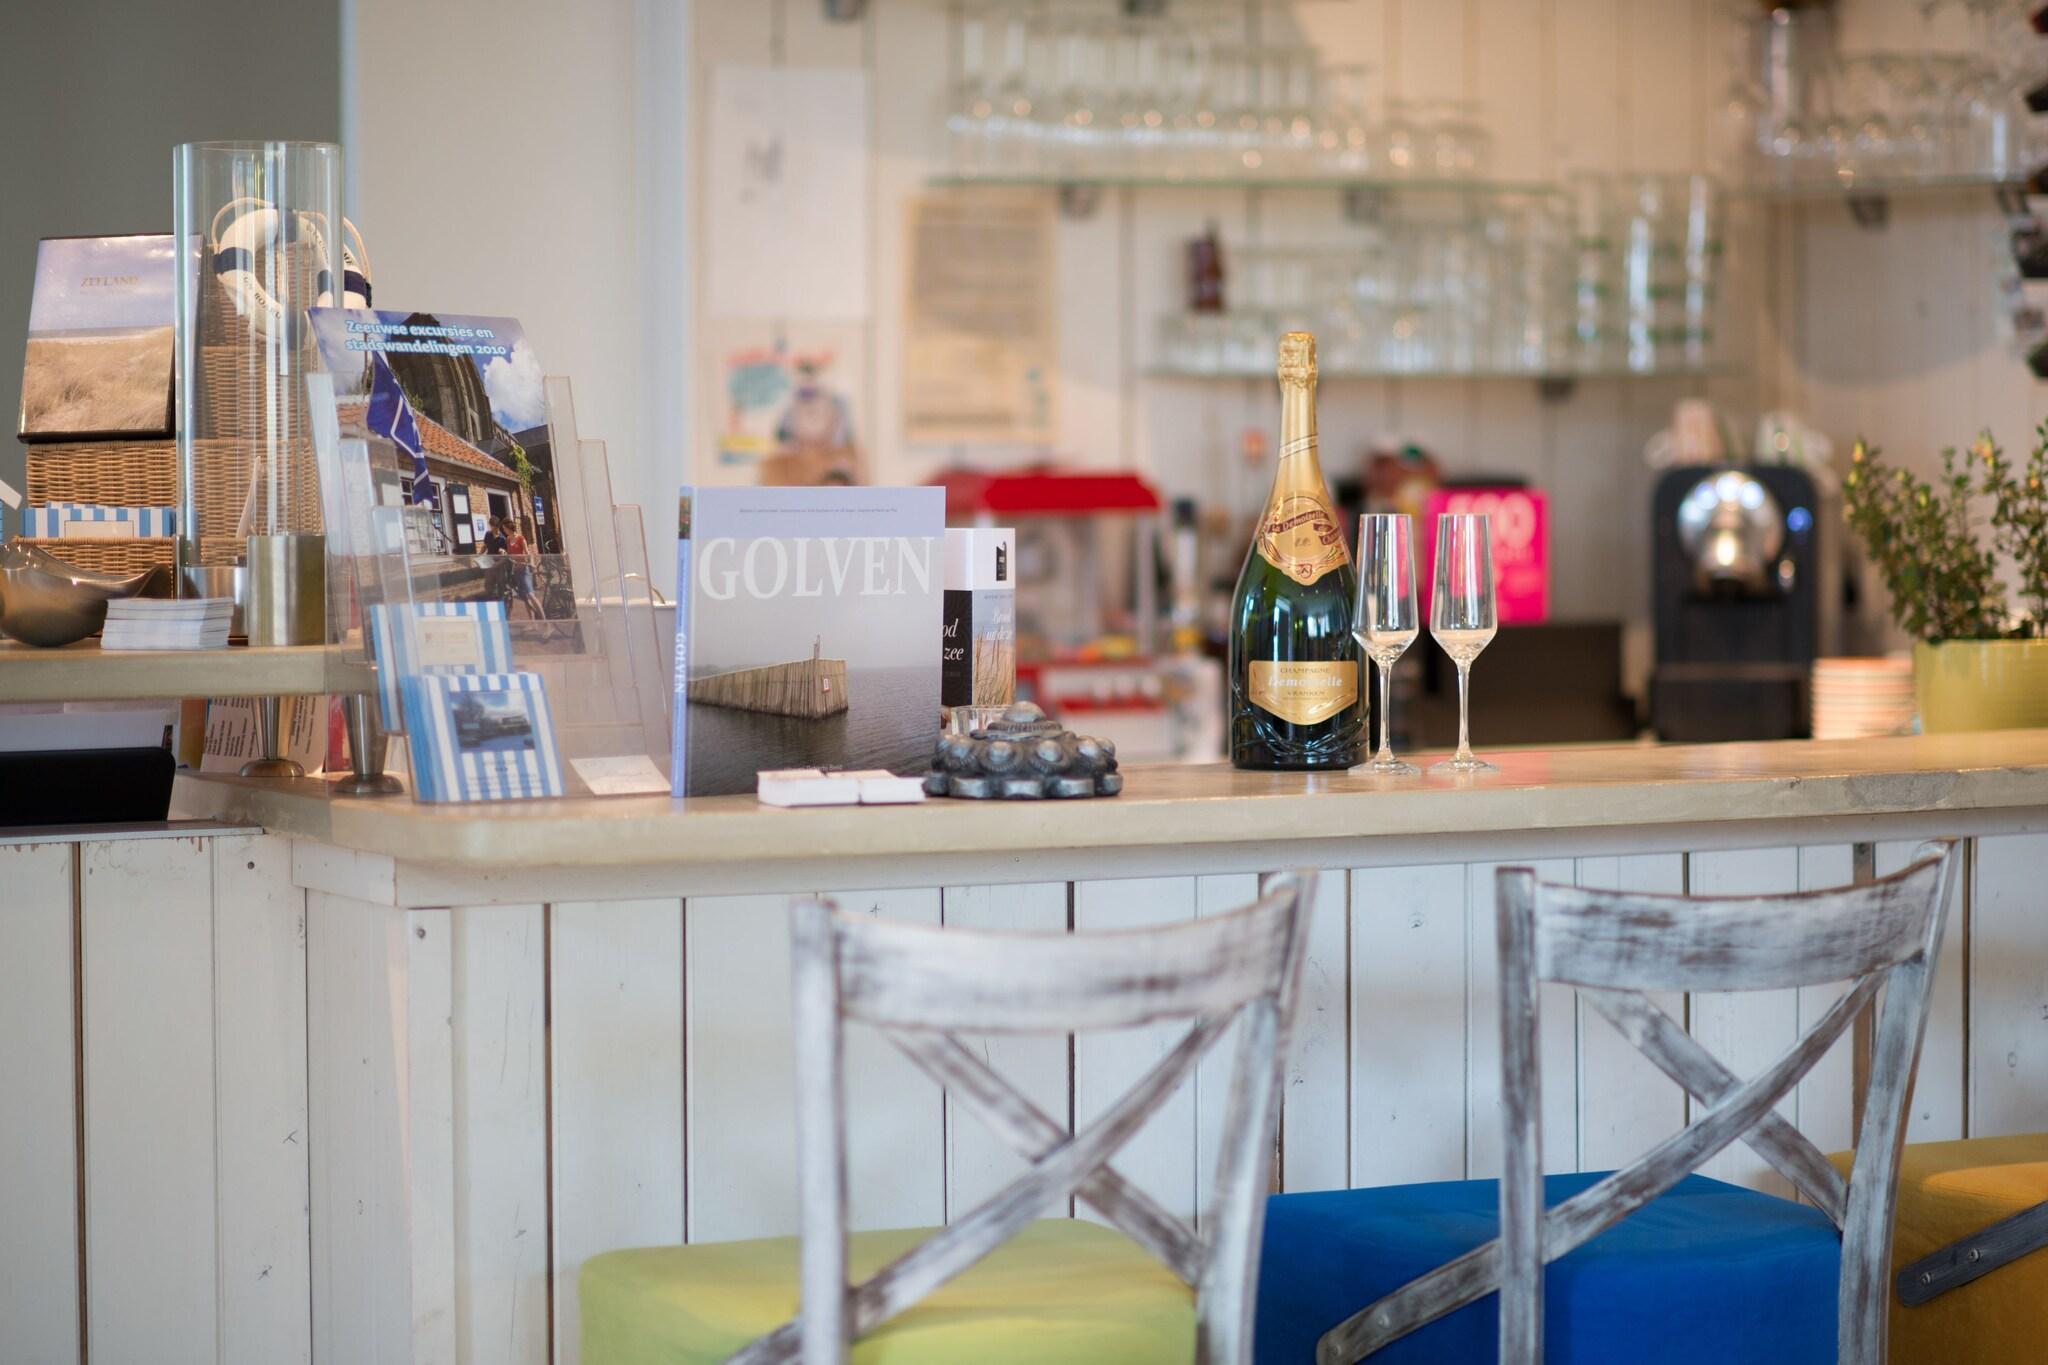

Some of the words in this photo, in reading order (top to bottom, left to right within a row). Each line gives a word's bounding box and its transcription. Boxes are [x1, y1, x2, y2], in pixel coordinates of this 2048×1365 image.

[345, 320, 408, 336] Zeeuwse
[409, 325, 474, 338] excursies
[476, 328, 494, 339] en
[345, 340, 475, 356] stadswandelingen
[477, 345, 507, 356] 2010
[699, 536, 936, 600] GOLVEN
[674, 632, 687, 694] GOLVEN
[944, 646, 965, 661] zee
